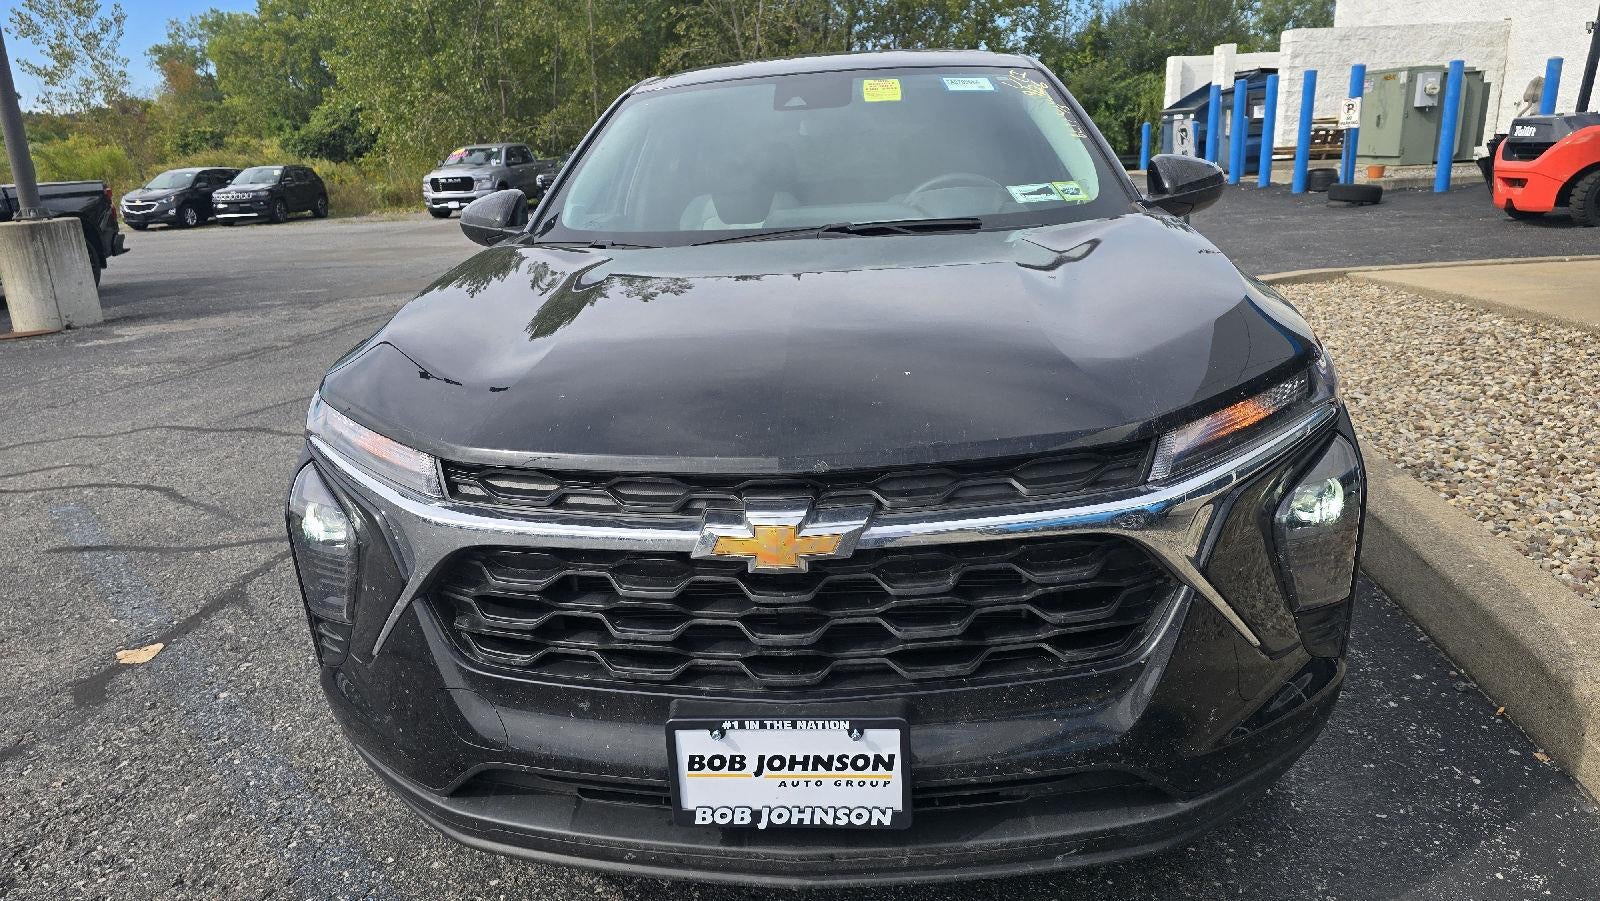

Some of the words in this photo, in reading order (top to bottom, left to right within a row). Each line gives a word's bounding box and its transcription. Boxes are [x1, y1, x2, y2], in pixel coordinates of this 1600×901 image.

[722, 721, 739, 730] #1
[745, 721, 760, 730] IN
[764, 721, 792, 730] THE
[797, 721, 850, 730] NATION
[687, 754, 747, 771] BOB
[753, 754, 895, 777] JOHNSON
[778, 780, 823, 788] AUTO
[834, 780, 891, 788] GROUP
[694, 807, 753, 825] BOB
[757, 807, 893, 829] JOHNSON
